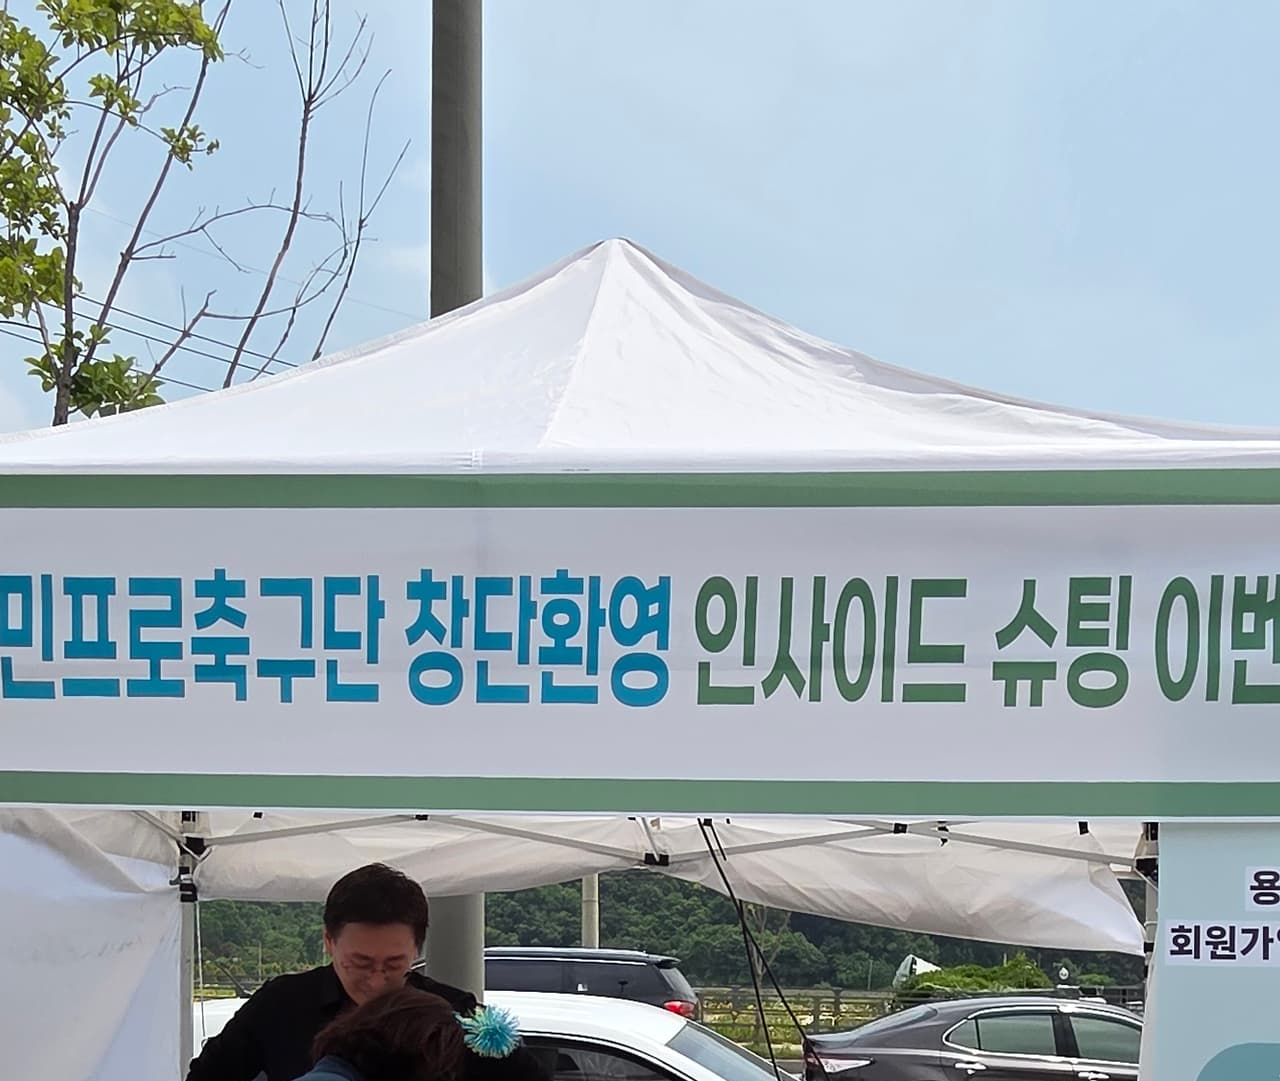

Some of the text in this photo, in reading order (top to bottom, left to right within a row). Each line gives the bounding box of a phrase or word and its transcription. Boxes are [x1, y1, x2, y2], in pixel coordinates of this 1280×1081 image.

[405, 569, 671, 707] 창단환영
[694, 574, 967, 706] 인사이드
[991, 574, 1130, 709] 슈팅
